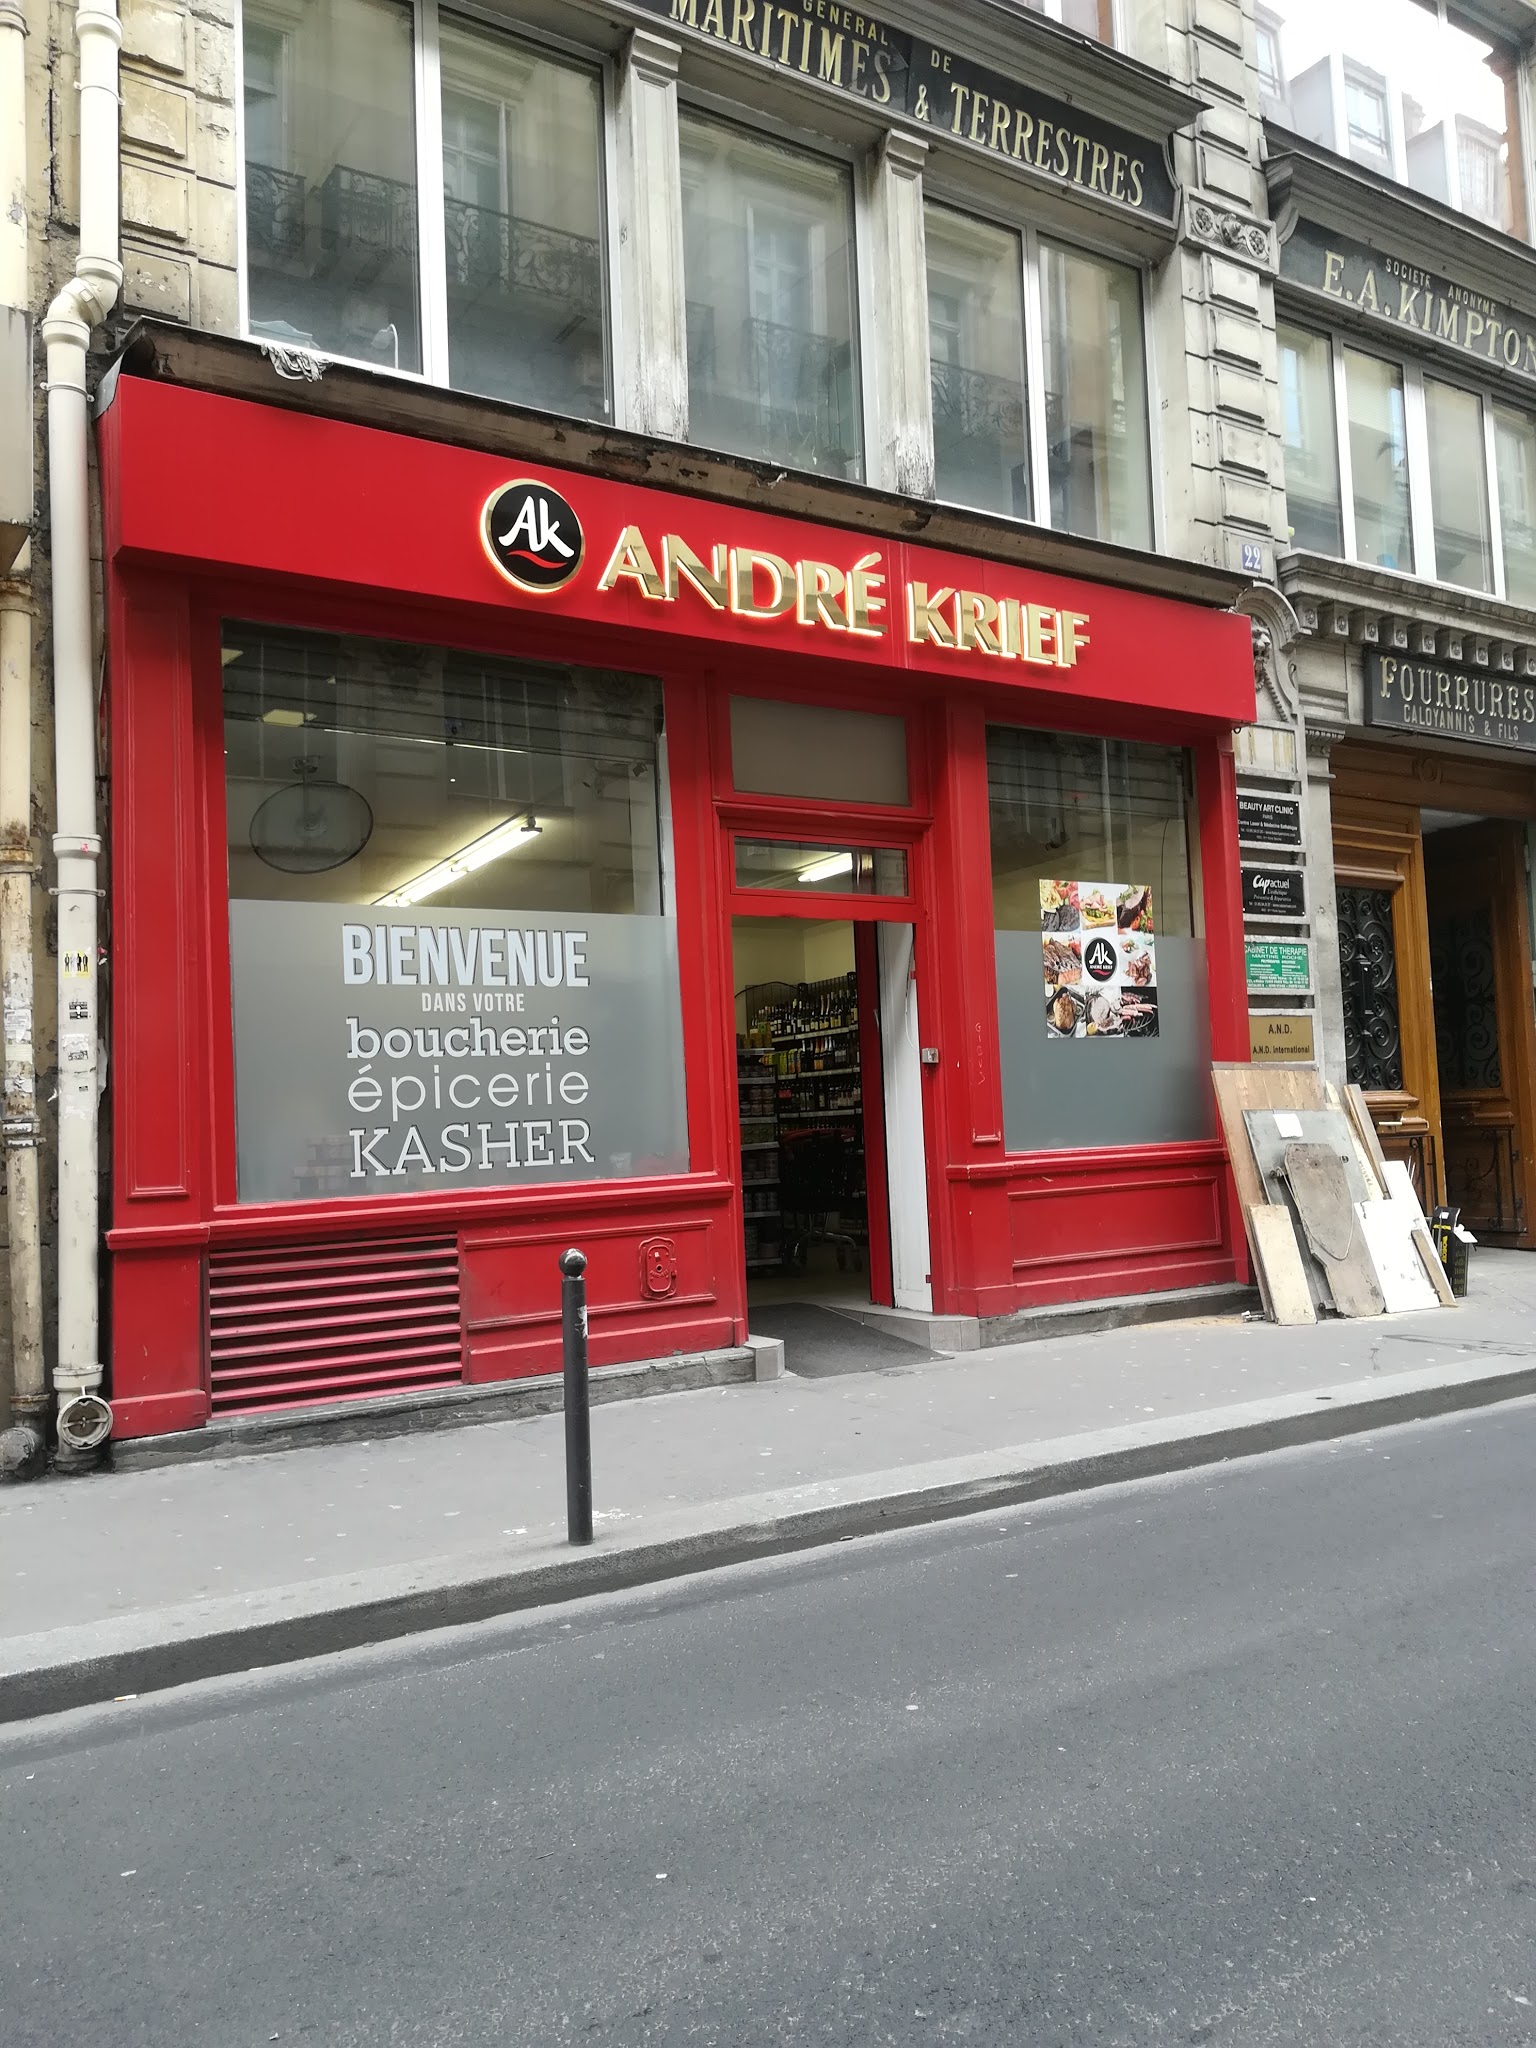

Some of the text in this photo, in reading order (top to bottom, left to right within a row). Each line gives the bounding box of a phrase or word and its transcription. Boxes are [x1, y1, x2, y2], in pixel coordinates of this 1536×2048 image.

[930, 50, 951, 74] DE
[914, 83, 930, 122] &
[950, 82, 1144, 207] TERRESTRES
[1448, 285, 1497, 317] ANONYME
[1244, 544, 1261, 570] 22
[596, 525, 1091, 669] ANDRÉ KRIEF
[1379, 655, 1536, 723] FOURRURES
[1403, 704, 1519, 741] CALOYANNIS & FILS
[1239, 801, 1294, 815] BEAUTY ART CLINIC
[1270, 879, 1290, 889] actuel
[343, 924, 590, 987] BIENVENUE
[1269, 946, 1279, 955] DE
[421, 993, 525, 1013] DANS VOTRE
[346, 1016, 591, 1059] boucherie
[1268, 1023, 1293, 1035] A.N.D.
[1252, 1045, 1272, 1055] A.N.D.
[348, 1062, 589, 1121] épicerie
[349, 1118, 595, 1178] KASHER
